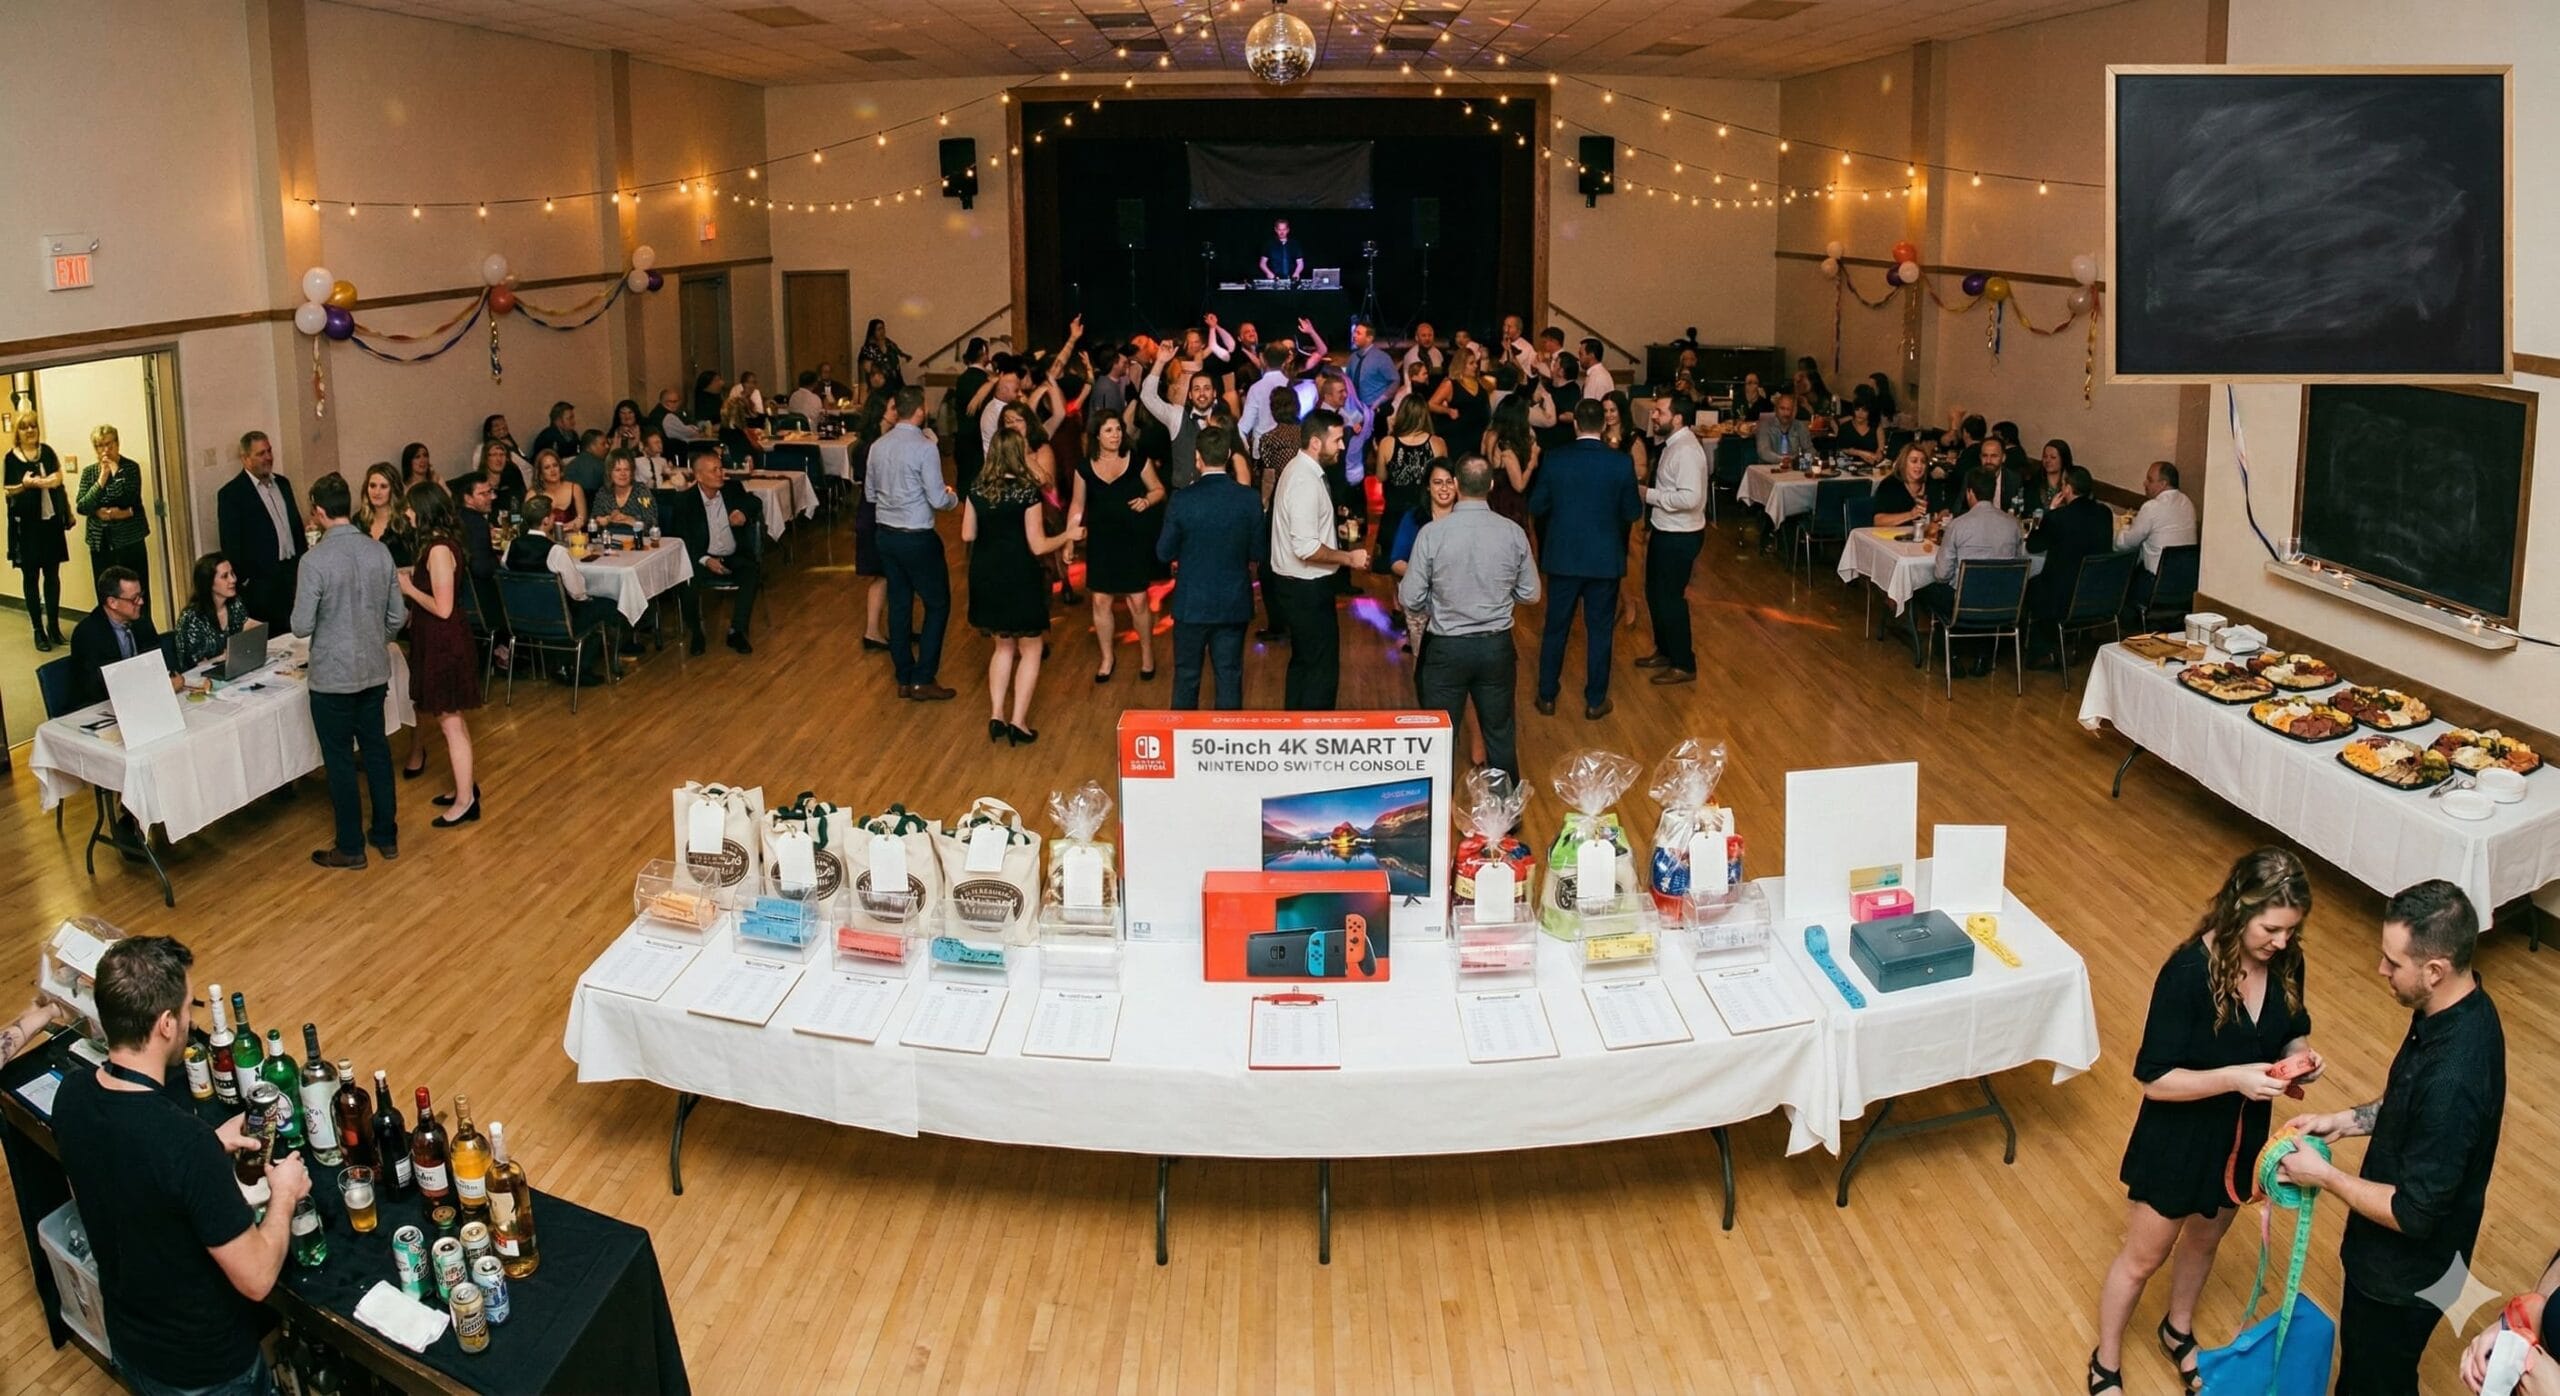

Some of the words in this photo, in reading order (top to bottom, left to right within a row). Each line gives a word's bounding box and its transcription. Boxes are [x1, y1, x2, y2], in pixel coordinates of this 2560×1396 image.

[55, 255, 88, 287] EXIT
[1191, 738, 1271, 756] 50-inch
[1277, 738, 1308, 756] 4K
[1314, 737, 1397, 756] SMART
[1403, 736, 1433, 755] TV
[1197, 760, 1279, 773] NINTENDO
[1284, 760, 1345, 772] SWITCH
[1349, 759, 1426, 772] CONSOLE
